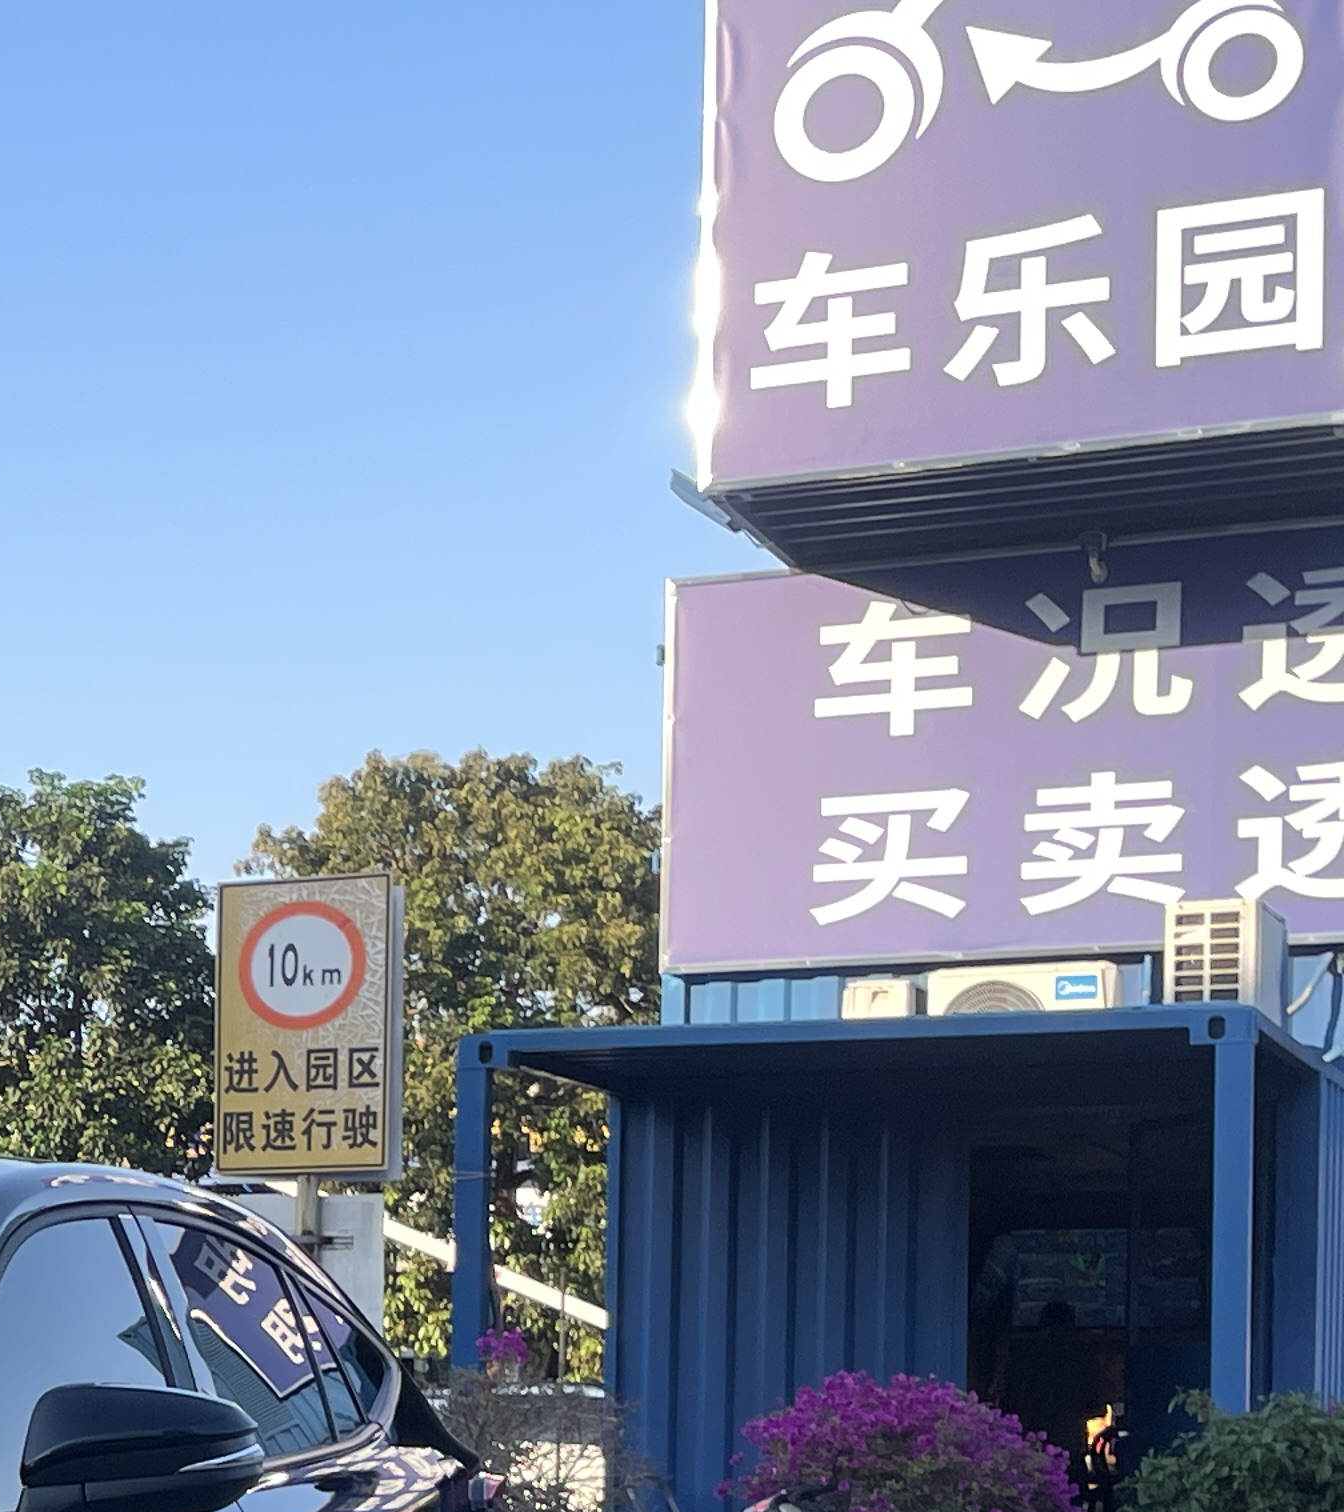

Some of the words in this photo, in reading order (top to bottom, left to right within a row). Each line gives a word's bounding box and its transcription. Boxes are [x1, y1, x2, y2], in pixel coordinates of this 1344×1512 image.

[749, 187, 1325, 409] 车乐园
[223, 1046, 381, 1094] 进入园区
[221, 1104, 378, 1155] 限速行驶
